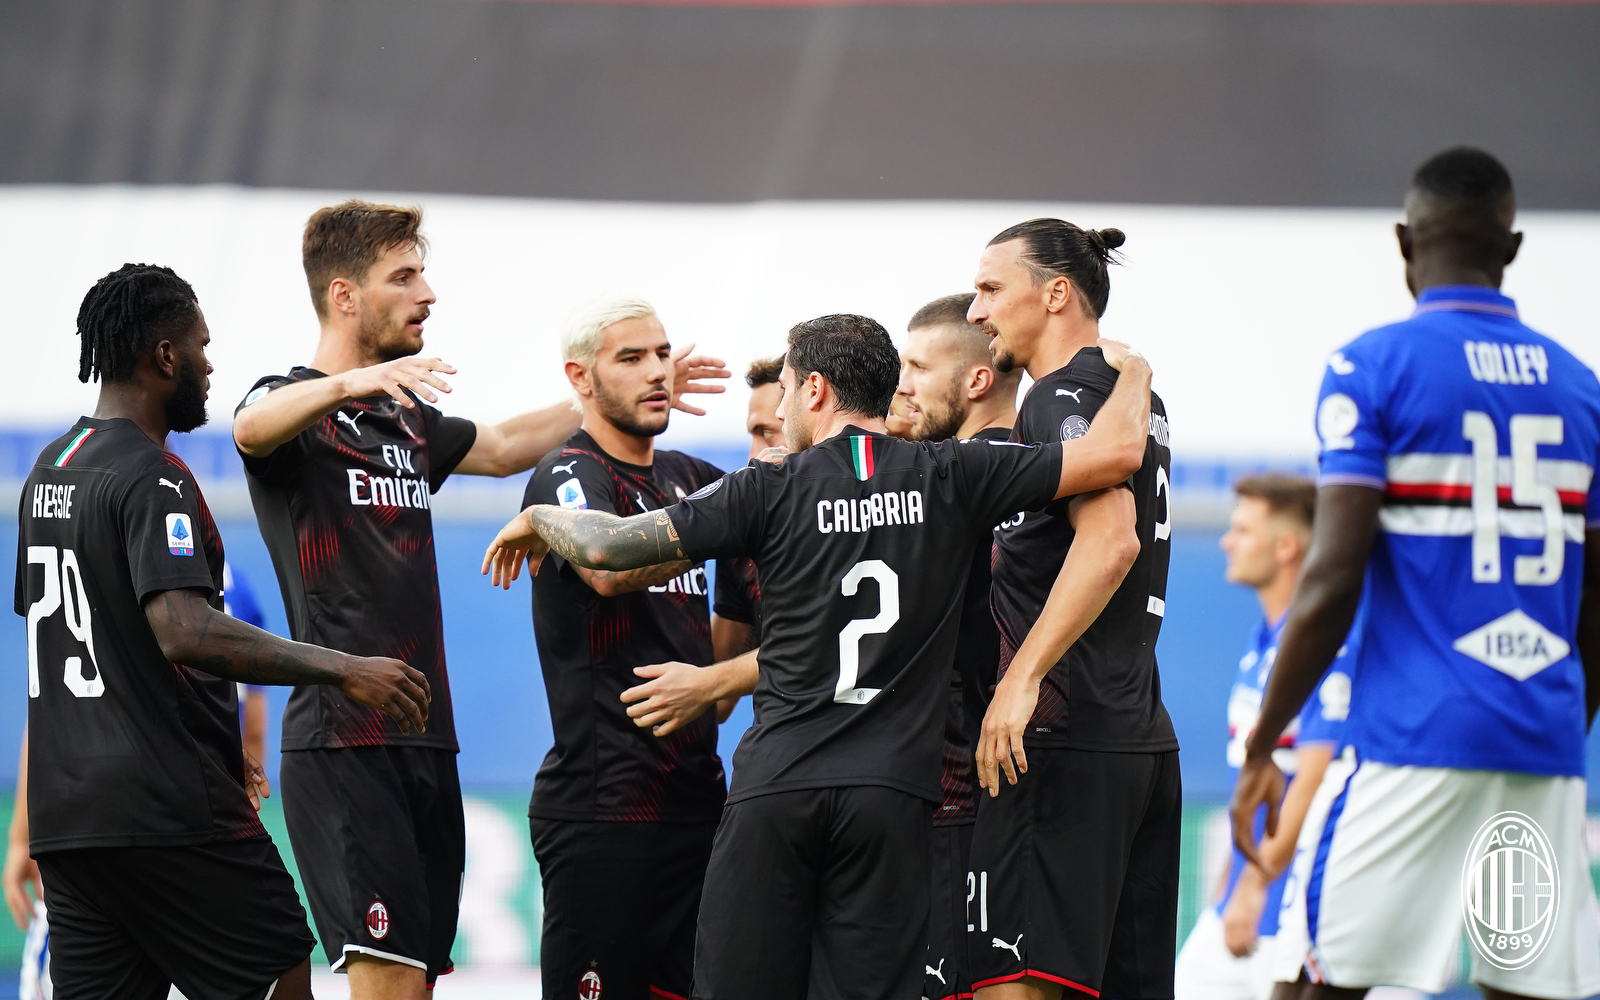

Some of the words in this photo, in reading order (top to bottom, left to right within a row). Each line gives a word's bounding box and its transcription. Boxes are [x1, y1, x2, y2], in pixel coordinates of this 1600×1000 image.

[1464, 340, 1549, 385] COLLEY
[382, 445, 415, 473] Fly
[33, 484, 76, 519] KESSIE
[816, 490, 924, 534] CALABRIA
[1462, 410, 1565, 586] 15
[27, 546, 105, 698] 79
[833, 559, 900, 705] 2
[1486, 632, 1549, 658] IBSA
[966, 871, 988, 932] 21
